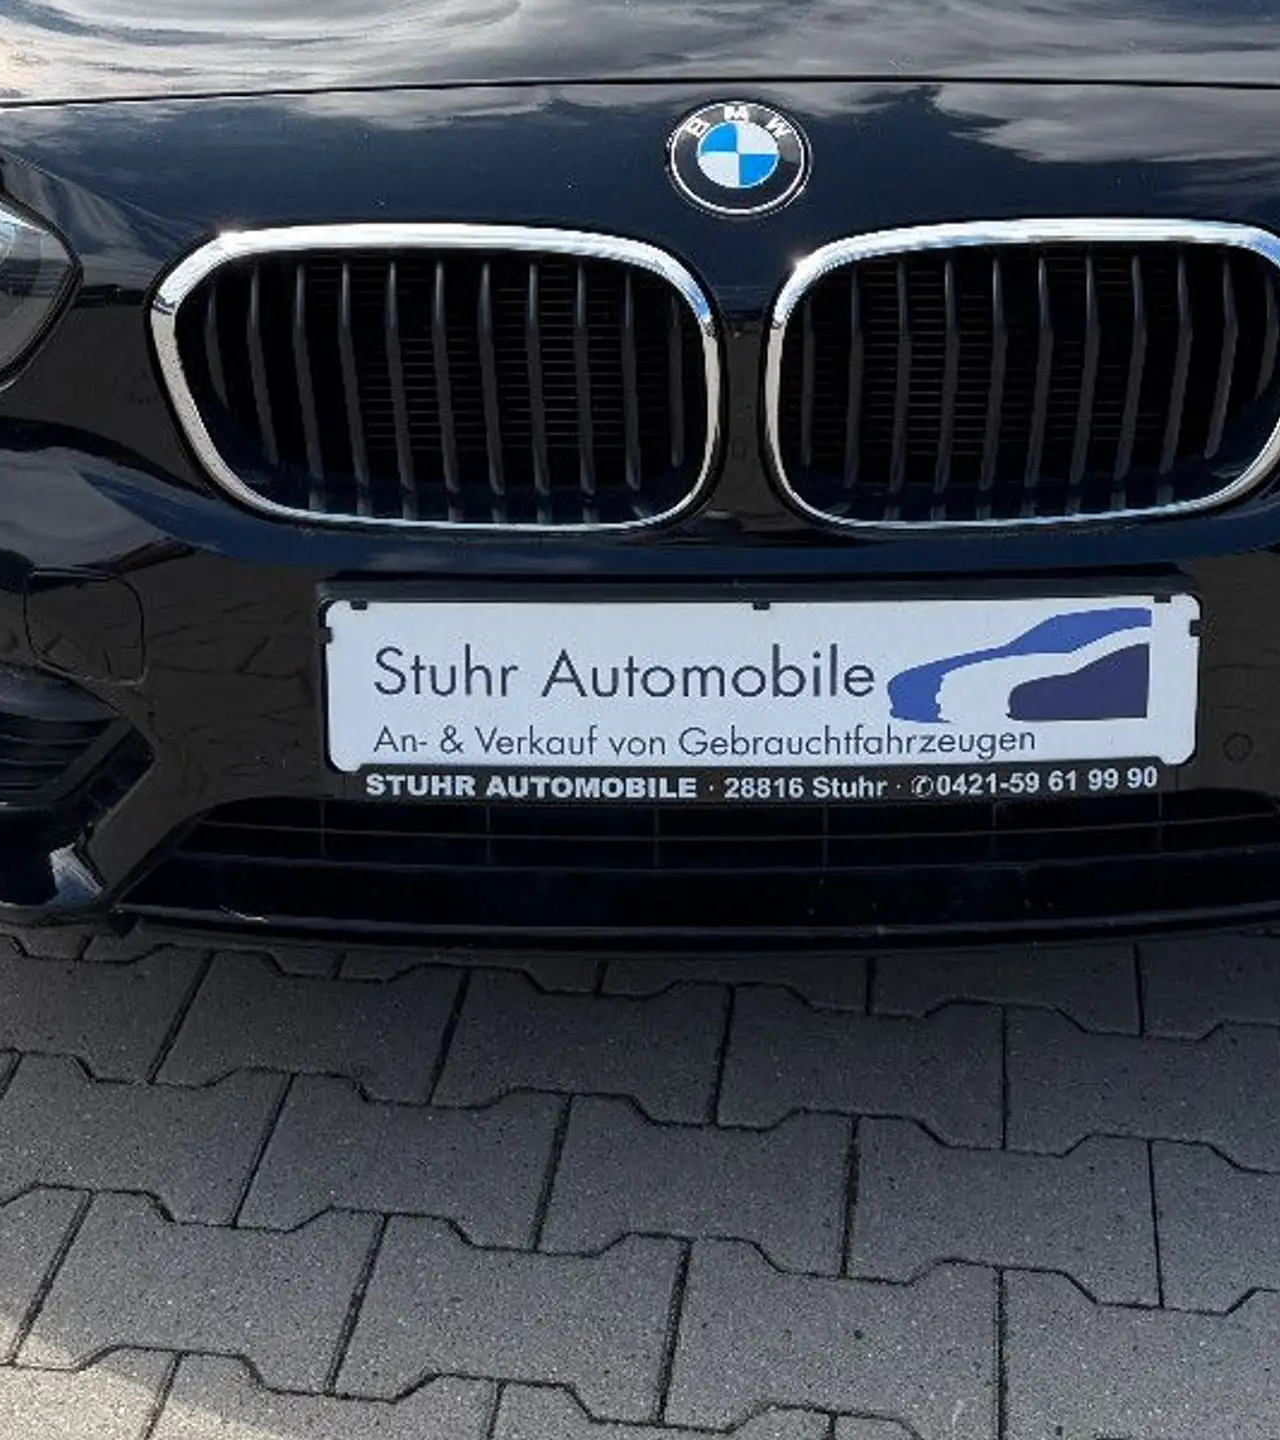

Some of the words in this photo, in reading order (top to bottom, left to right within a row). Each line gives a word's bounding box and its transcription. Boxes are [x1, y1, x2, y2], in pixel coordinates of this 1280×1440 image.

[684, 104, 793, 139] BMW
[373, 643, 518, 698] Stuhr
[541, 643, 876, 698] Automobile
[373, 724, 428, 757] An-
[439, 725, 465, 757] &
[473, 723, 601, 757] Verkauf
[610, 734, 668, 757] von
[677, 724, 1037, 762] Gebrauchtfahrzeugen
[365, 774, 476, 799] STUHR
[486, 774, 699, 800] AUTOMOBILE
[723, 776, 803, 800] 28816
[812, 775, 889, 799] Stuhr
[1047, 770, 1077, 792] 61
[1087, 767, 1120, 791] 99
[1126, 765, 1159, 790] 90
